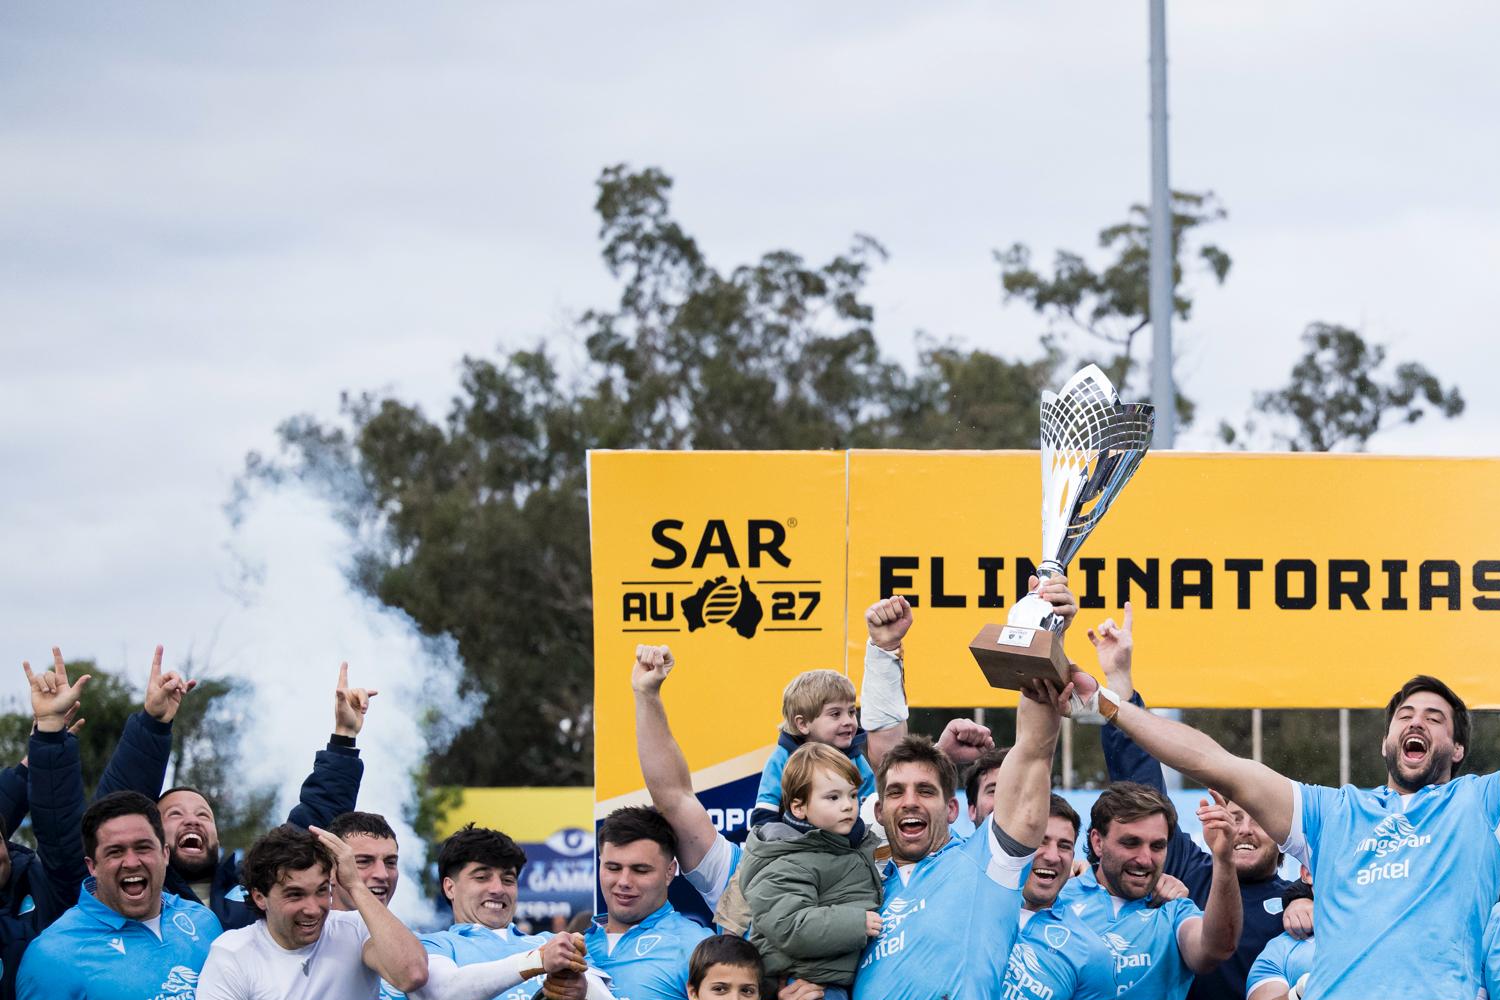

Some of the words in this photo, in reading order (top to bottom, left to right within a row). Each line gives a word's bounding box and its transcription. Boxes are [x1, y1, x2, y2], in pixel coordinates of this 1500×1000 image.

[623, 592, 674, 621] AU
[771, 591, 821, 620] 27
[706, 808, 754, 831] OP
